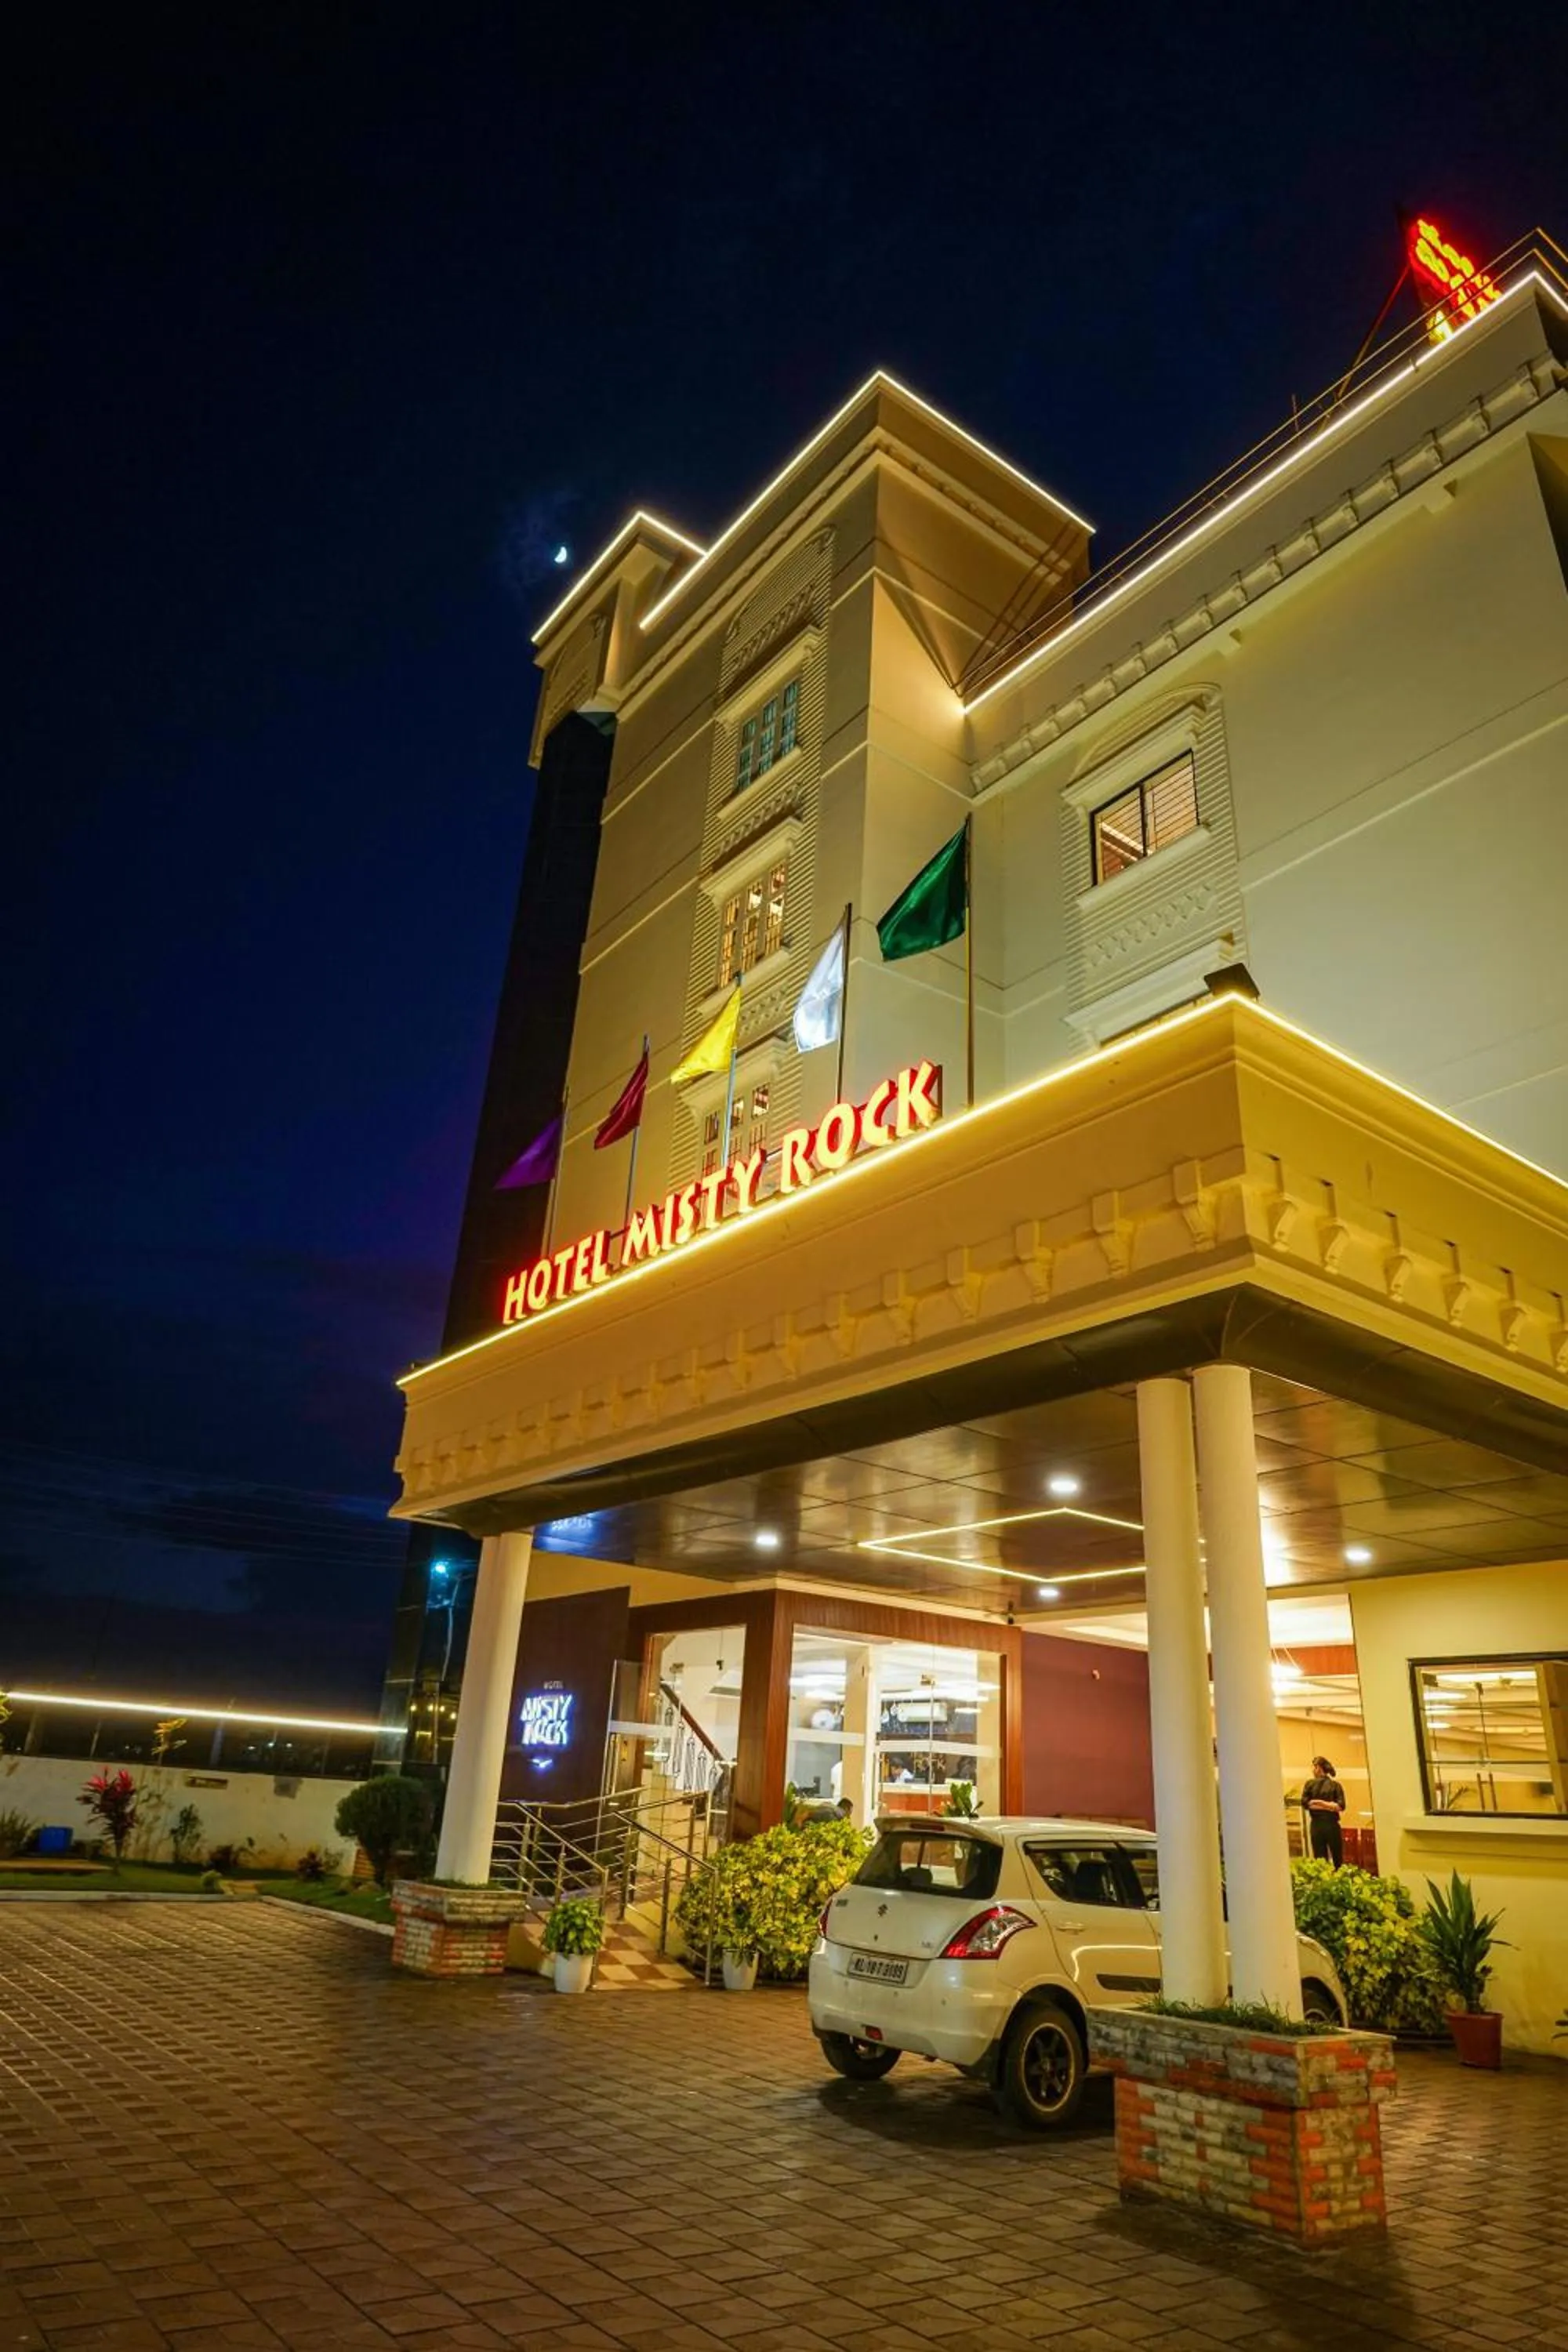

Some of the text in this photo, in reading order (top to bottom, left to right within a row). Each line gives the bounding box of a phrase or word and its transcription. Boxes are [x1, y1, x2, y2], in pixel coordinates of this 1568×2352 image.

[502, 1061, 941, 1324] HOTEL MISTY ROCK
[520, 1693, 573, 1722] MISTY
